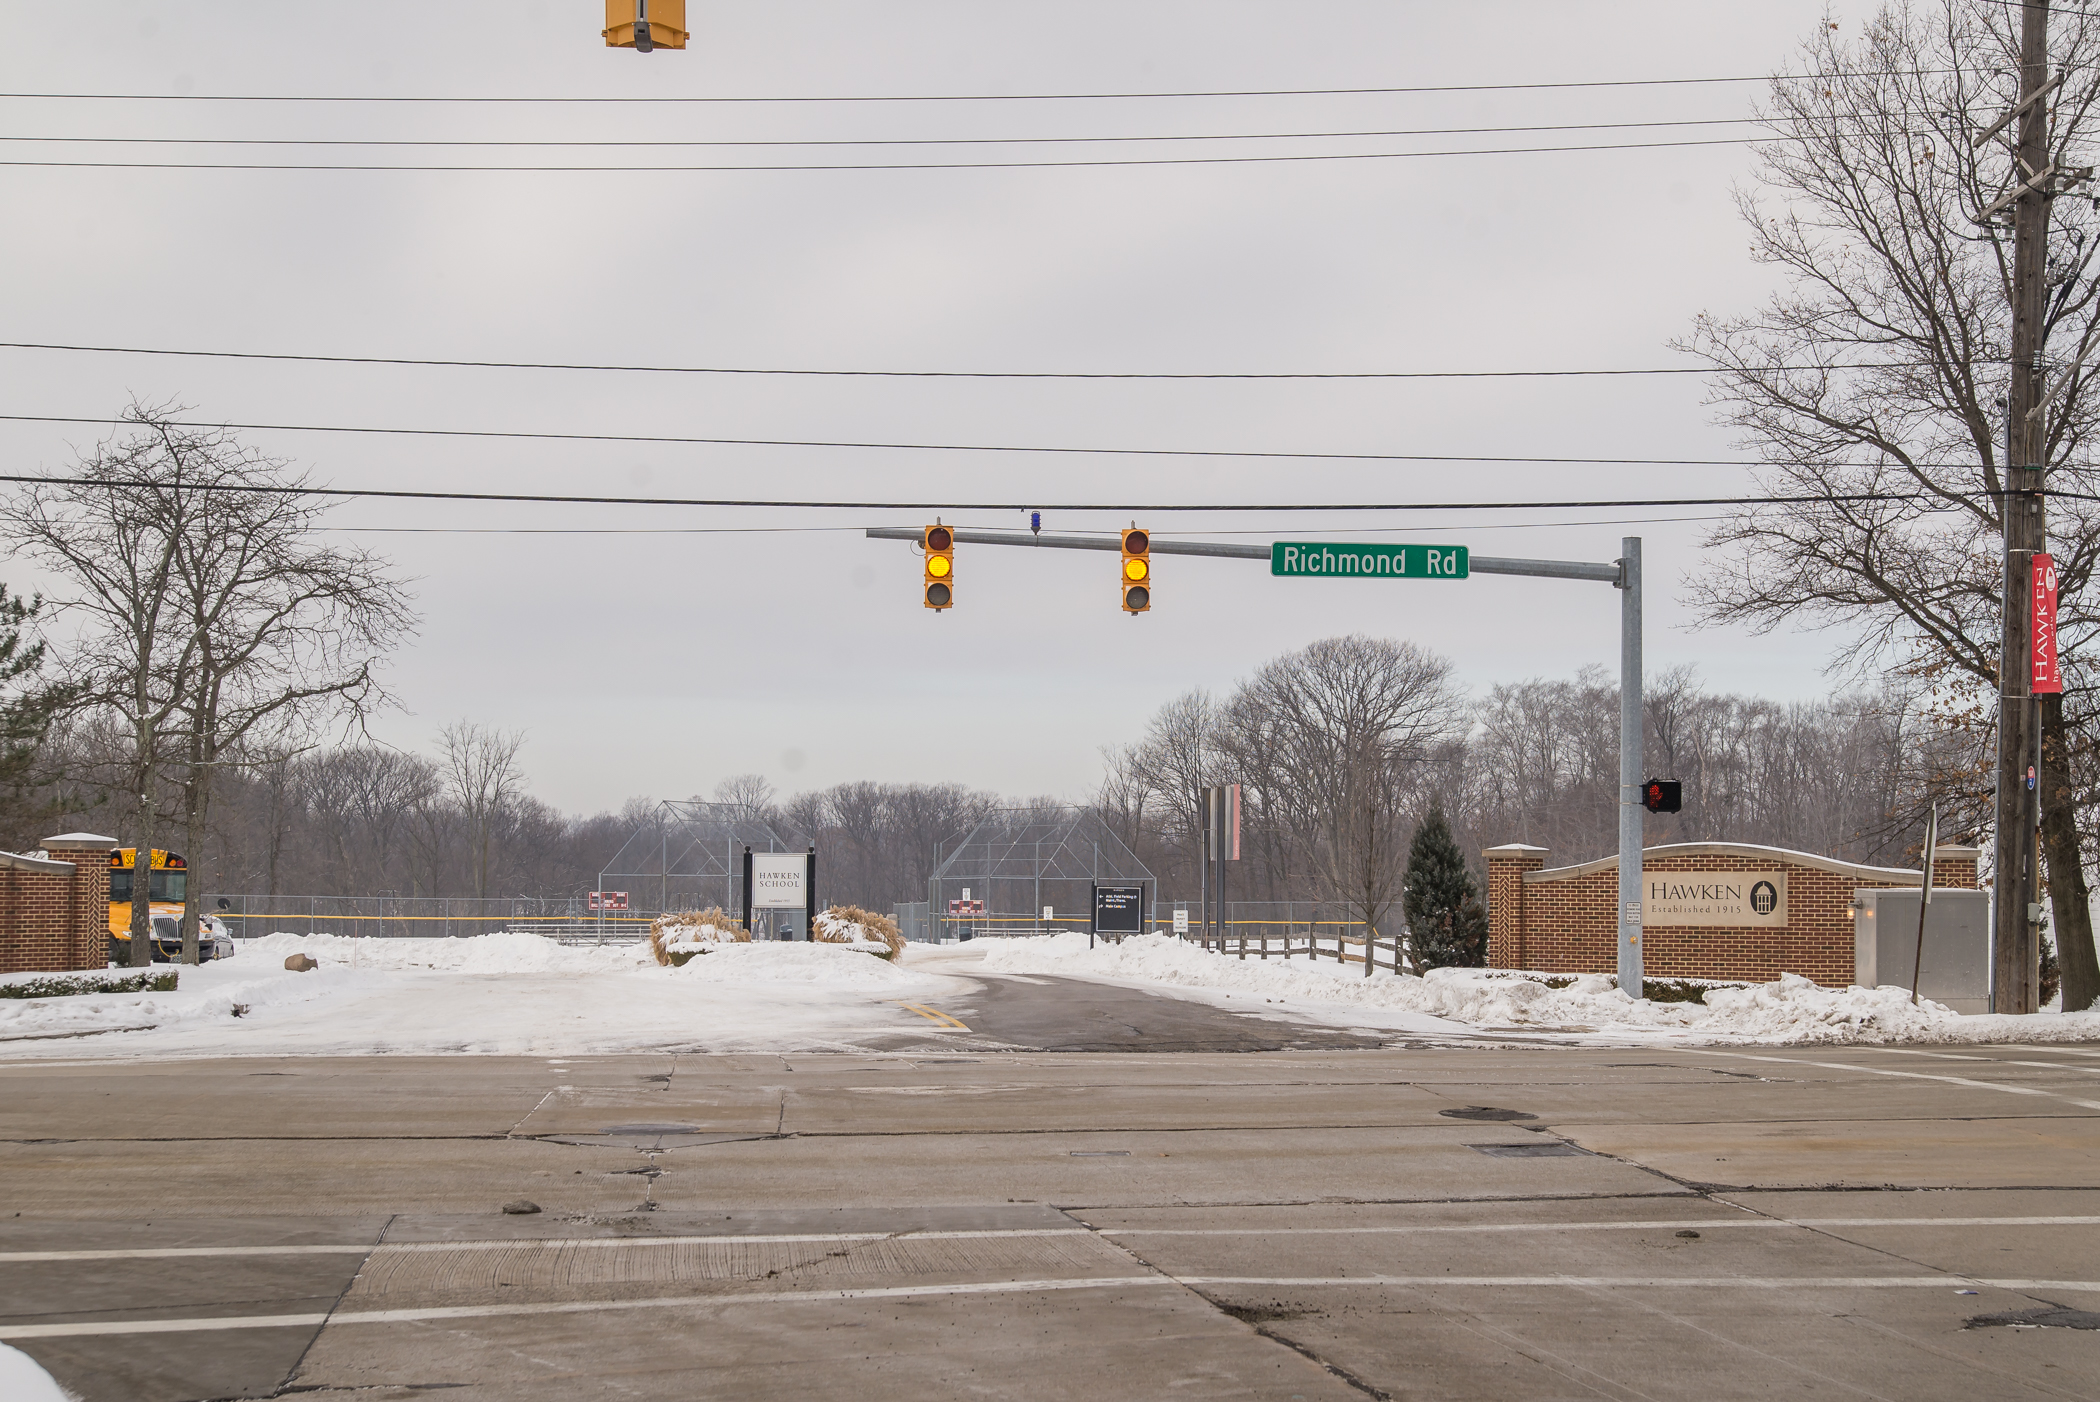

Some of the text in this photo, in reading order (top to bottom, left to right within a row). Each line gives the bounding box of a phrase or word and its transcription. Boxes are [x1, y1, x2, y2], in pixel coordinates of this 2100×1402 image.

[1284, 546, 1457, 575] Richmond Rd
[2035, 567, 2049, 683] HAWKEN
[759, 872, 800, 880] HAWKEN
[759, 880, 800, 888] SCHOOL
[1651, 882, 1741, 900] HAWKEN
[1651, 904, 1711, 914] Established
[1717, 905, 1742, 914] 1915
